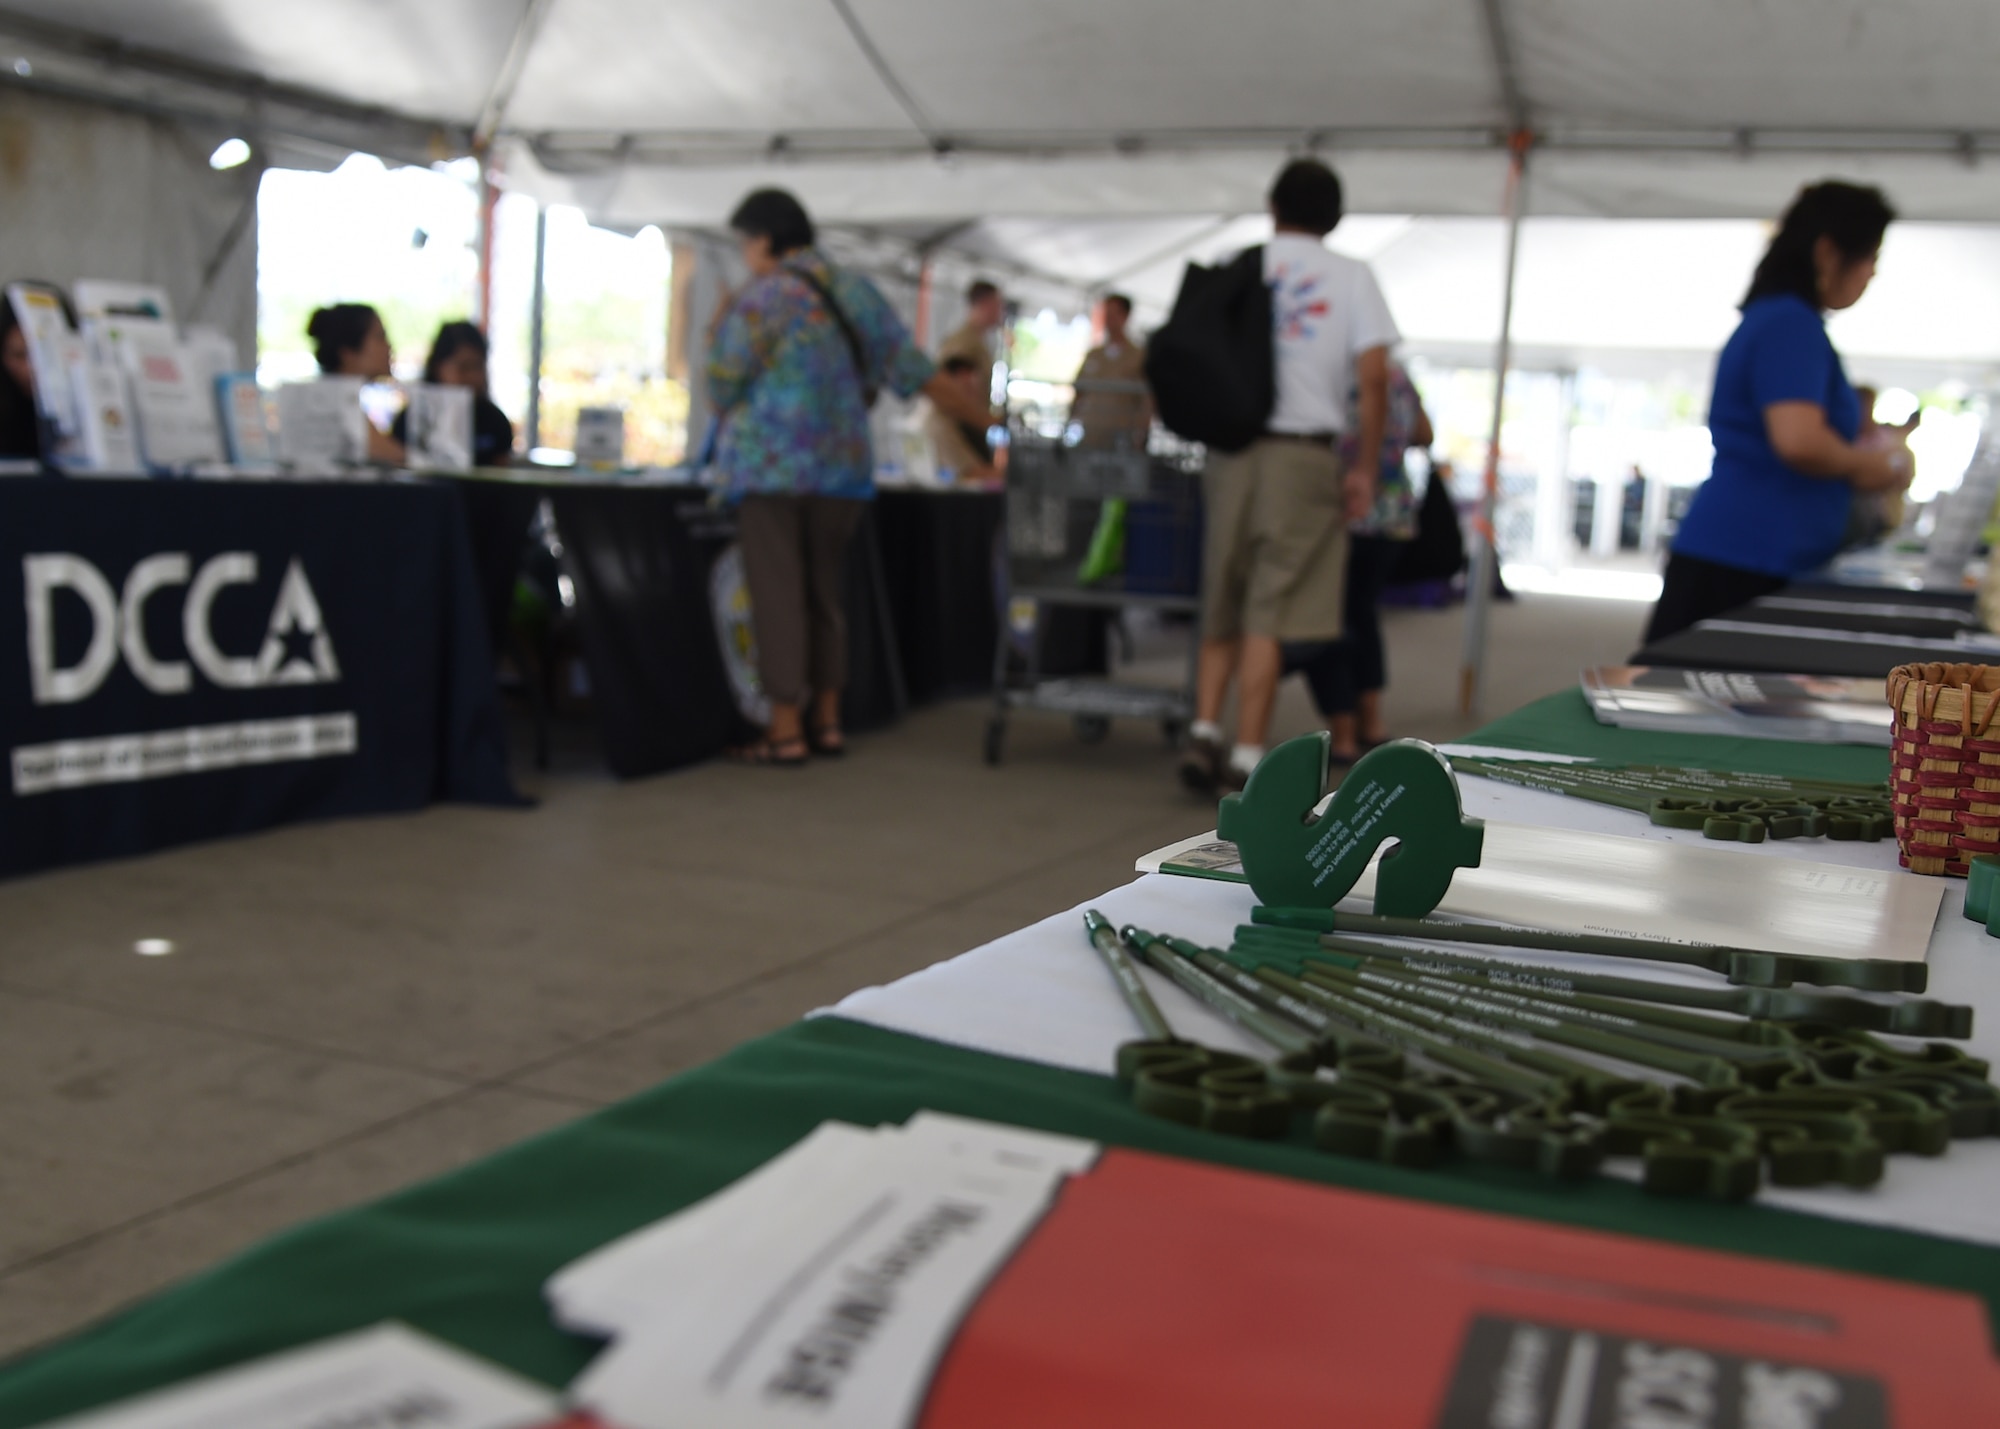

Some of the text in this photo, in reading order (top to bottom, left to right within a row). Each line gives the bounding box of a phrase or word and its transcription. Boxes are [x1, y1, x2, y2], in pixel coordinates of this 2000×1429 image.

[22, 551, 341, 705] DCCA
[1354, 779, 1378, 805] Hickam
[1367, 786, 1385, 806] Pearl
[1349, 802, 1371, 826] Harbor
[1311, 784, 1406, 888] Military & Family Support Center
